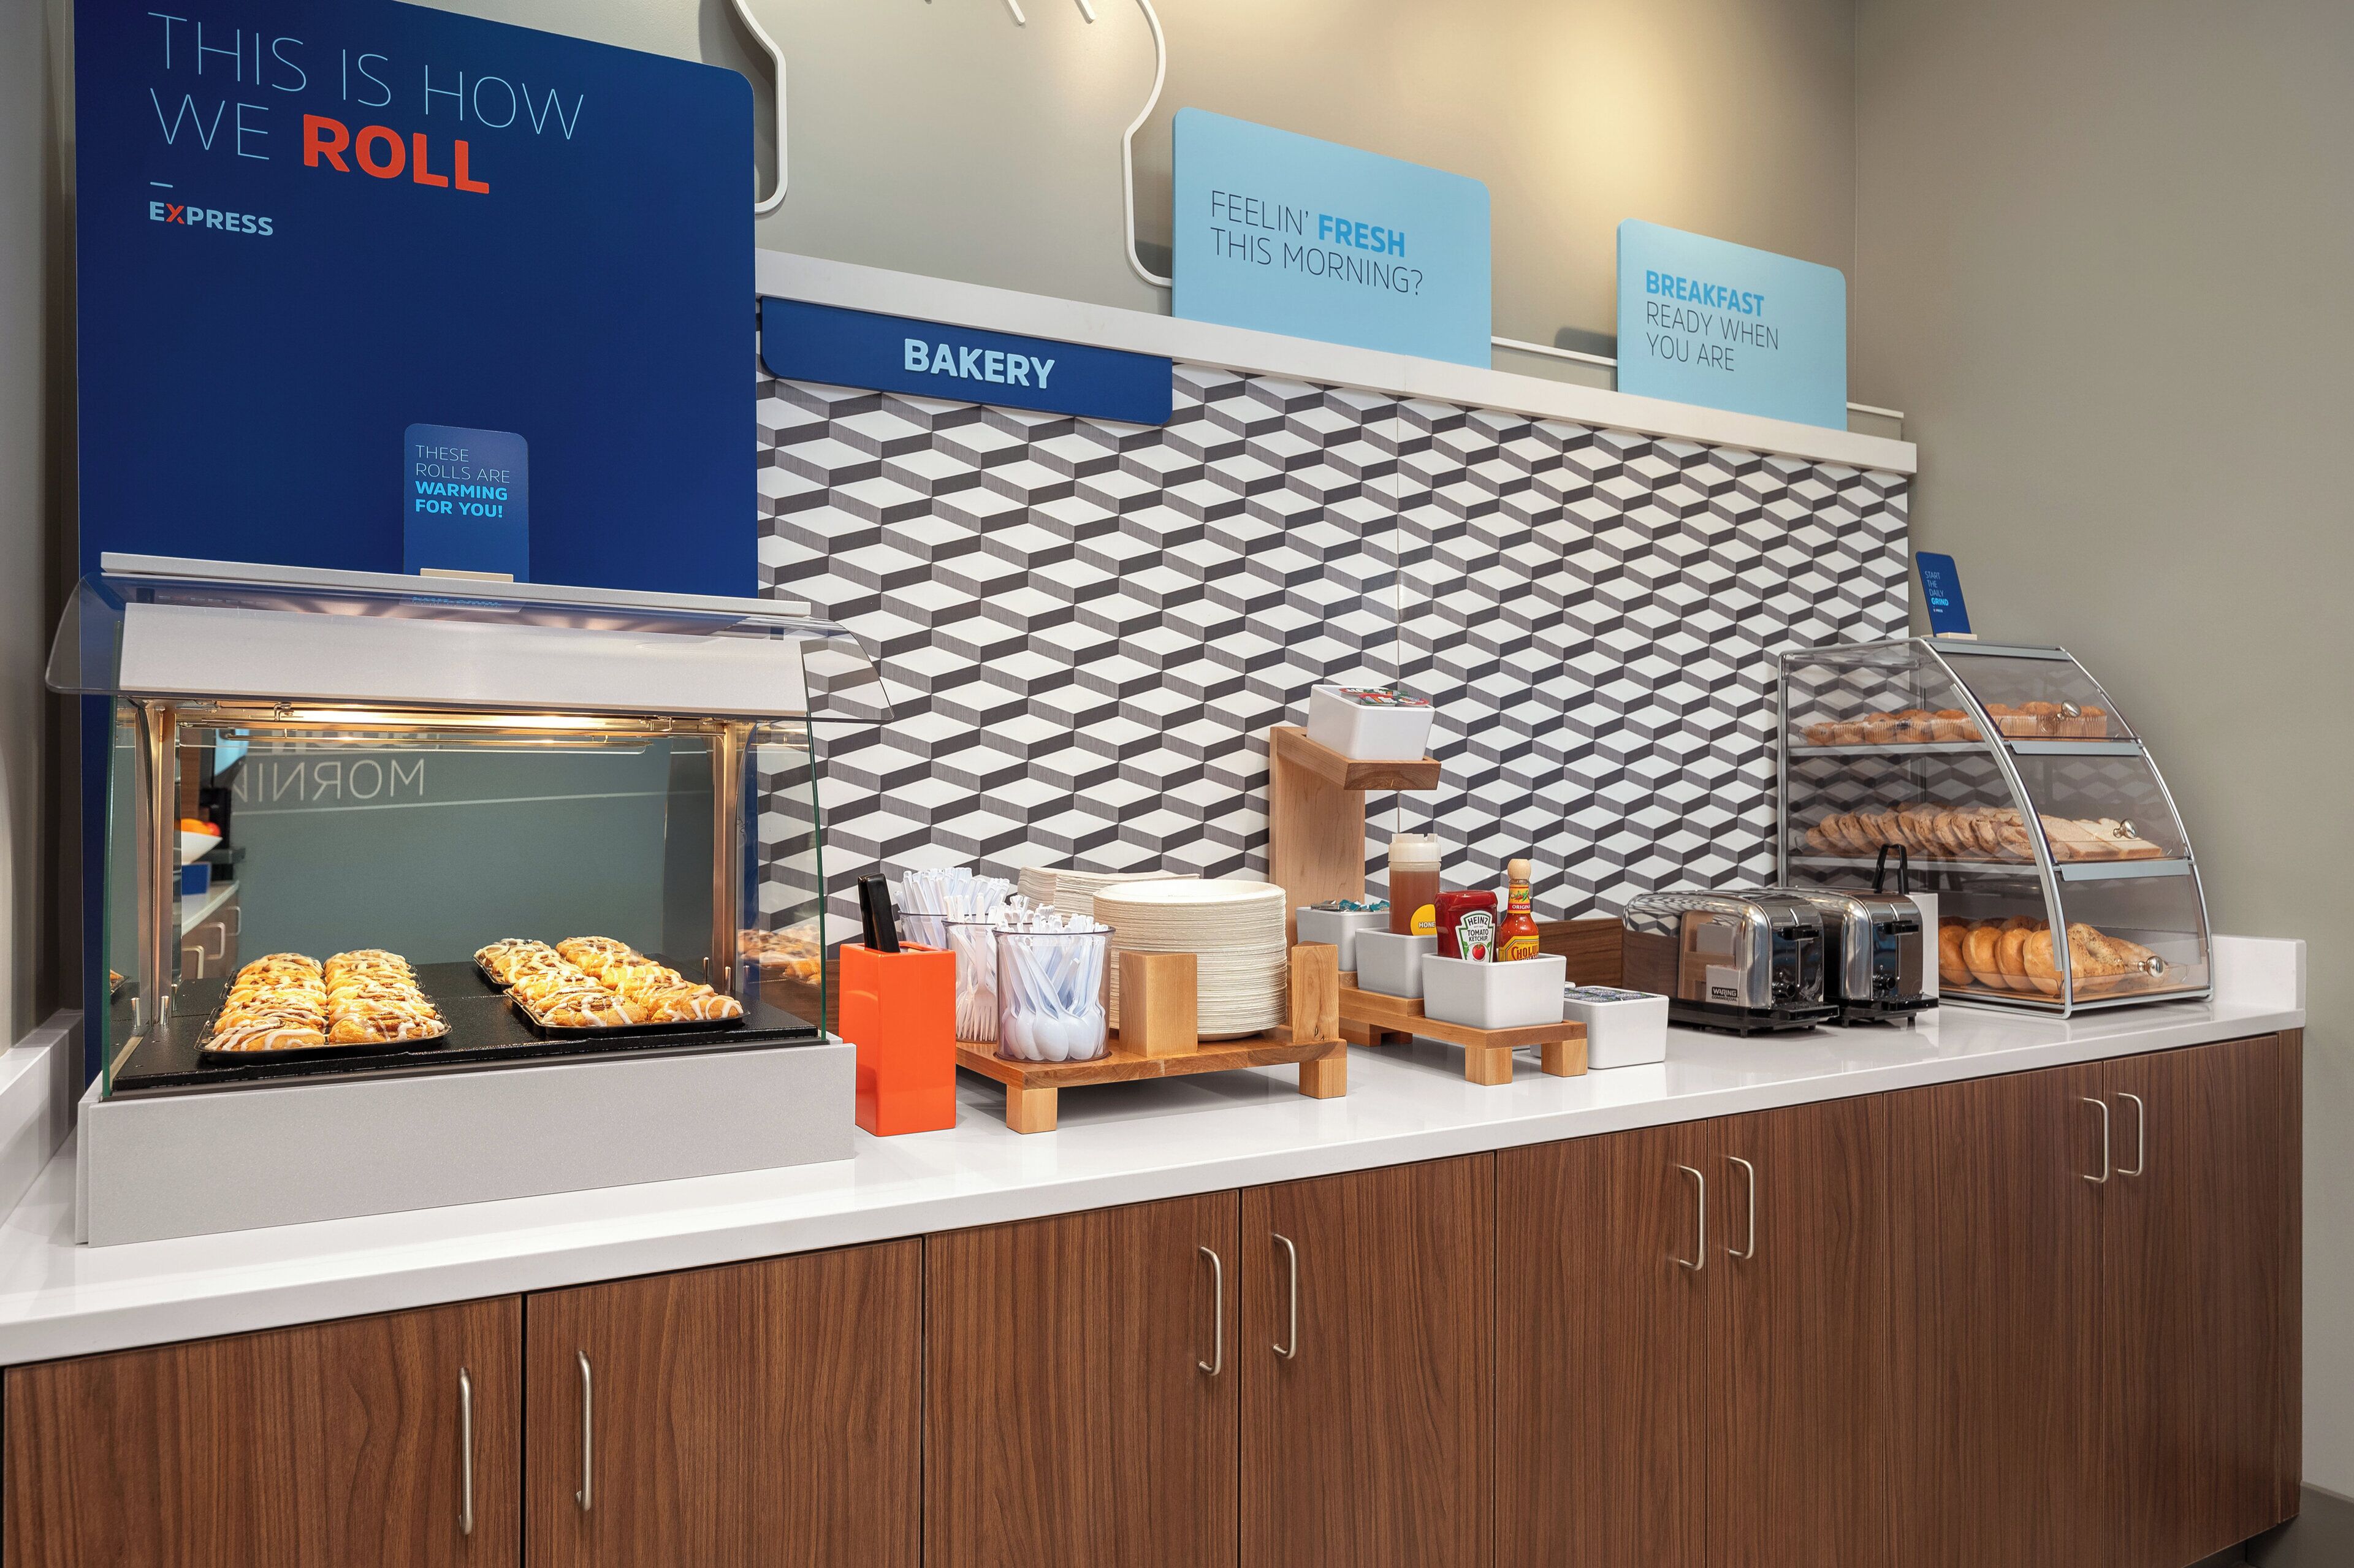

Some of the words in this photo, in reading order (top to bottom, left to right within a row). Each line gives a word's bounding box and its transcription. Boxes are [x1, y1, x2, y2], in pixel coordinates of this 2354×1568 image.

[147, 12, 307, 92] THIS
[342, 48, 390, 107] IS
[425, 64, 584, 140] HOW
[150, 88, 269, 160] WE
[303, 113, 490, 194] ROLL
[149, 200, 274, 236] EXPRESS
[1319, 213, 1405, 258] FRESH
[1210, 227, 1271, 265] THIS
[1284, 242, 1423, 295] MORNING?
[1646, 269, 1765, 317] BREAKFAST
[1647, 300, 1713, 336] READY
[1720, 316, 1778, 350] WHEN
[1646, 332, 1689, 362] YOU
[1697, 343, 1734, 371] ARE
[904, 338, 1056, 389] BAKERY
[415, 444, 469, 462] THESE
[416, 462, 471, 480] ROLLS
[476, 468, 510, 484] ARE
[415, 481, 508, 501] WARMING
[416, 498, 452, 514] FOR
[459, 501, 503, 518] YOU!
[1924, 571, 1941, 580] START
[1926, 580, 1938, 588] THE
[1929, 588, 1944, 597] DAILY
[1468, 916, 1488, 926] HEINZ
[1511, 945, 1539, 961] CHOLUL
[1712, 988, 1737, 997] WARING
